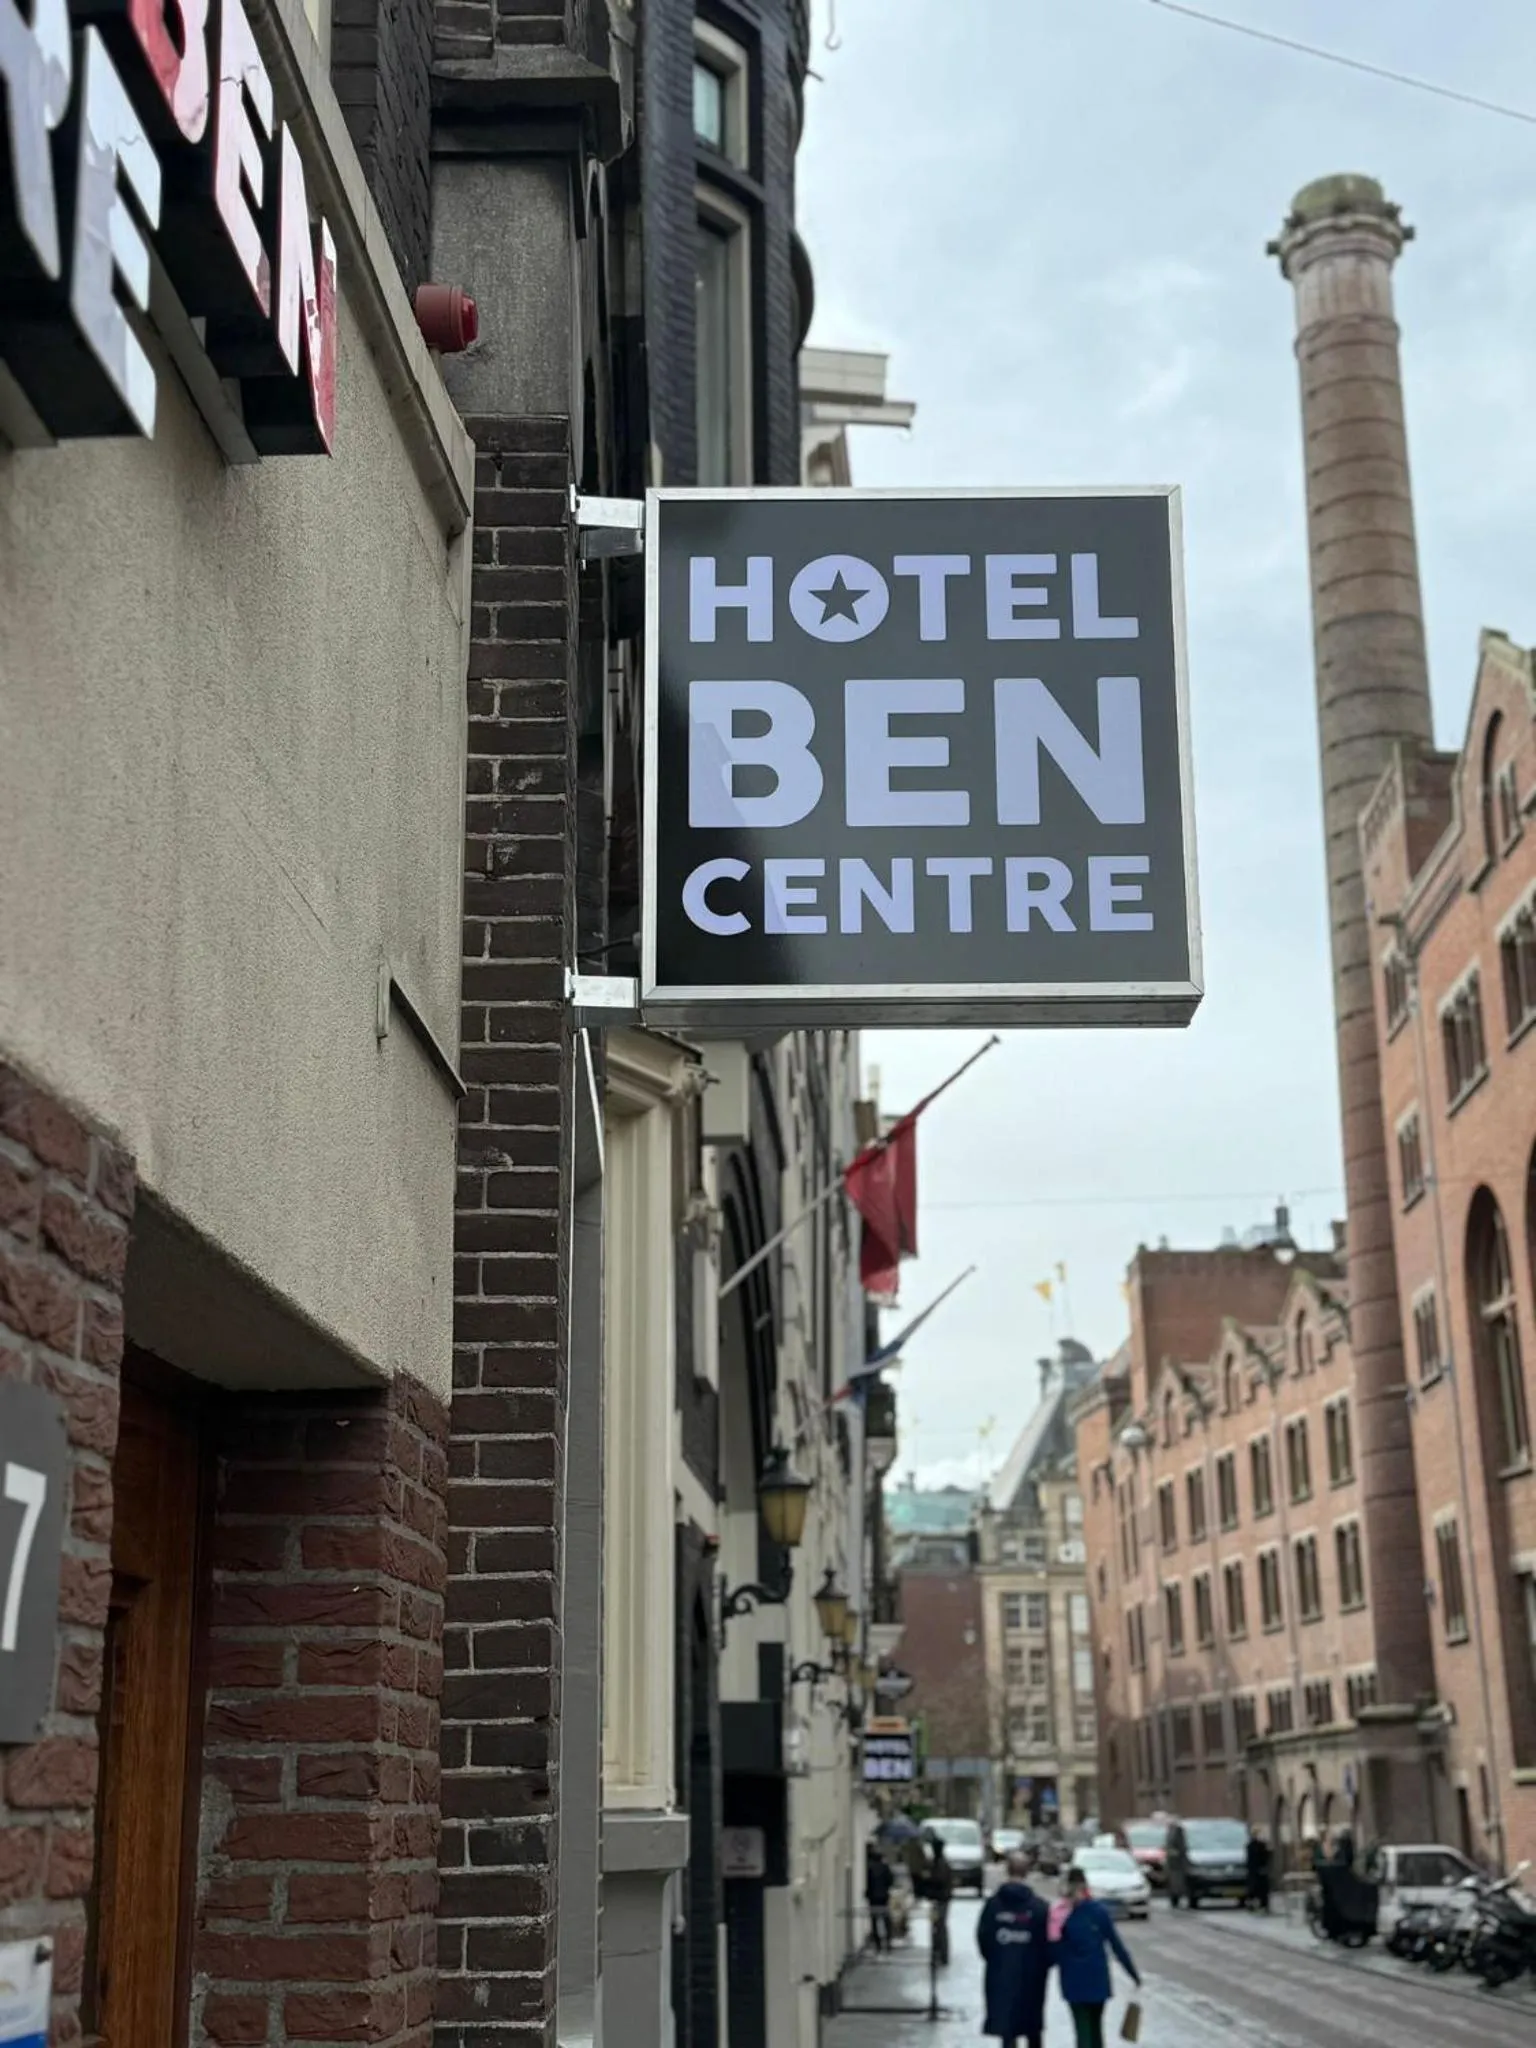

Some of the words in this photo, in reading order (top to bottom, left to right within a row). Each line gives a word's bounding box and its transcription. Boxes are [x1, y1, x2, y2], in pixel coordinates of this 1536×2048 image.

[689, 553, 1139, 643] HOTEL
[688, 677, 1146, 828] BEN
[682, 856, 1155, 936] CENTRE
[3, 1461, 47, 1652] 7
